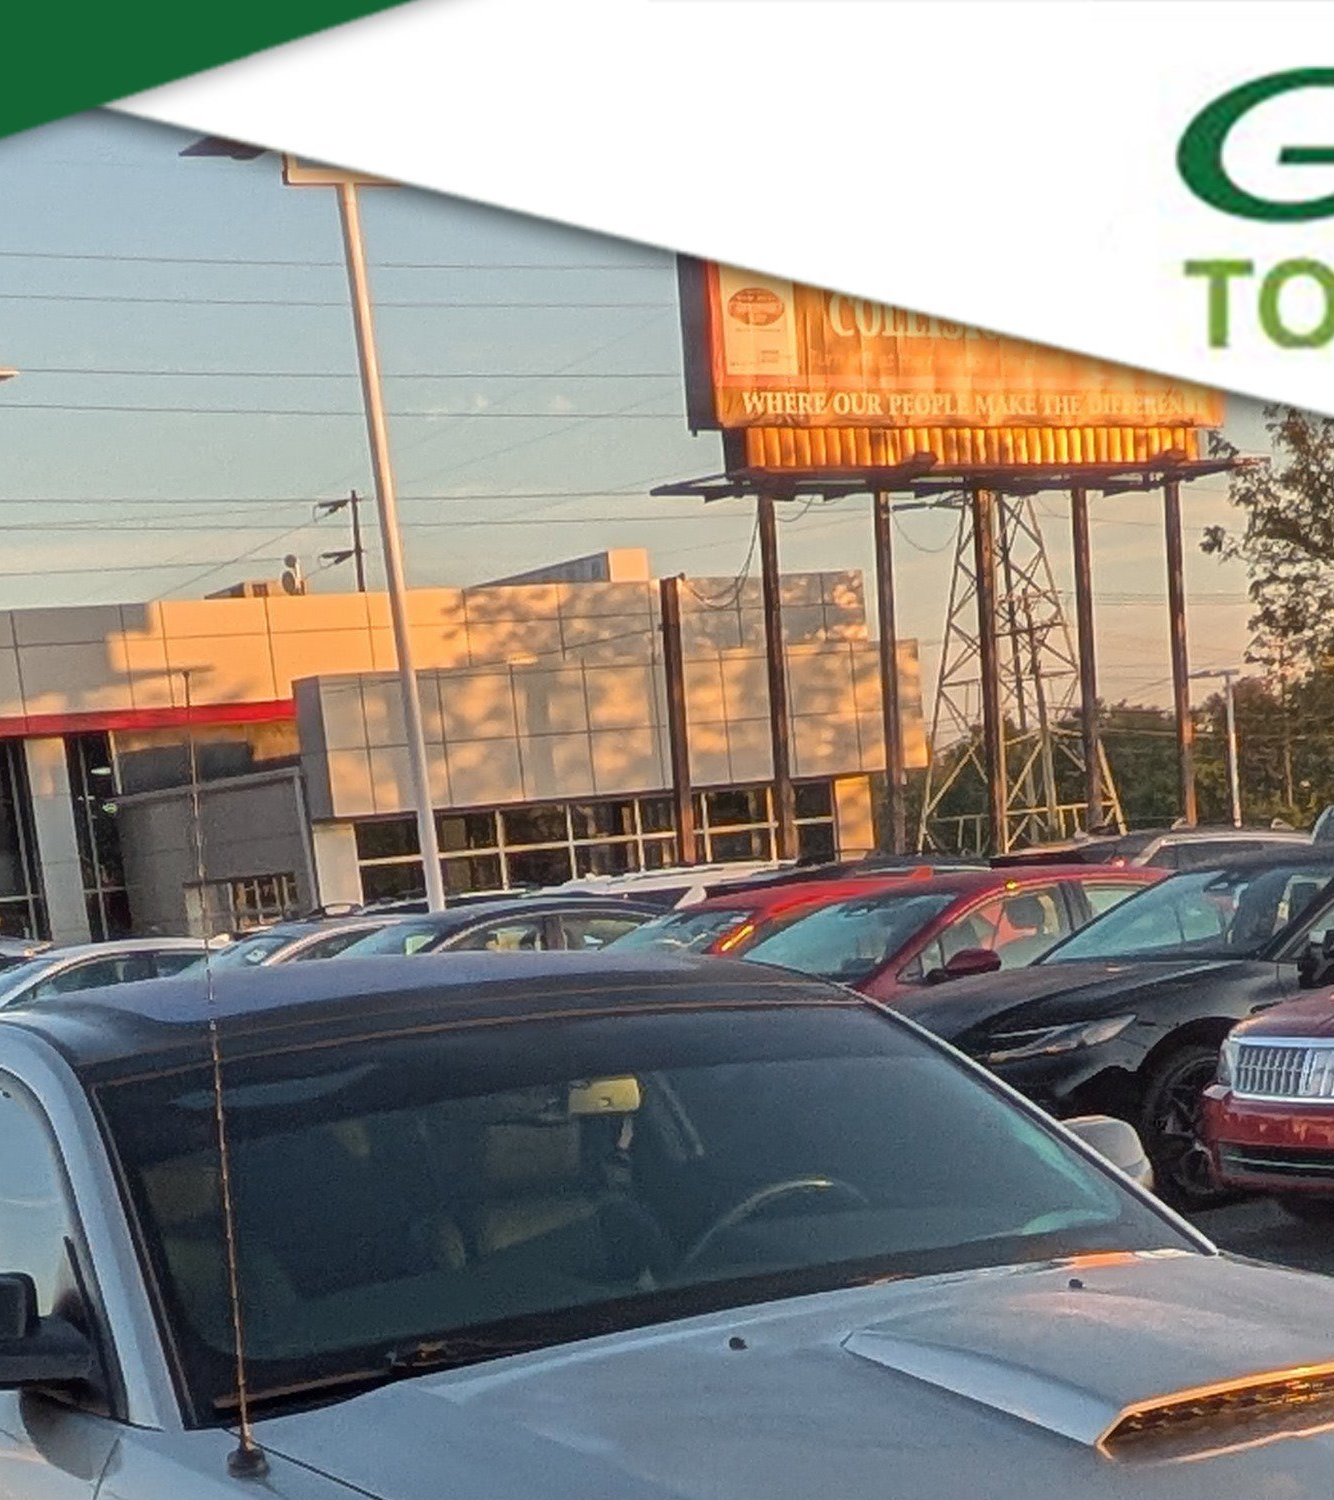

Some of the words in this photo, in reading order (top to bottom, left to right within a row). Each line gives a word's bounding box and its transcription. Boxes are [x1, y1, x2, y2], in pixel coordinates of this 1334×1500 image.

[742, 391, 827, 416] WHERE
[833, 391, 883, 415] OUR
[888, 391, 969, 415] PEOPLE
[974, 393, 1037, 415] MAKE
[1041, 394, 1080, 415] THE
